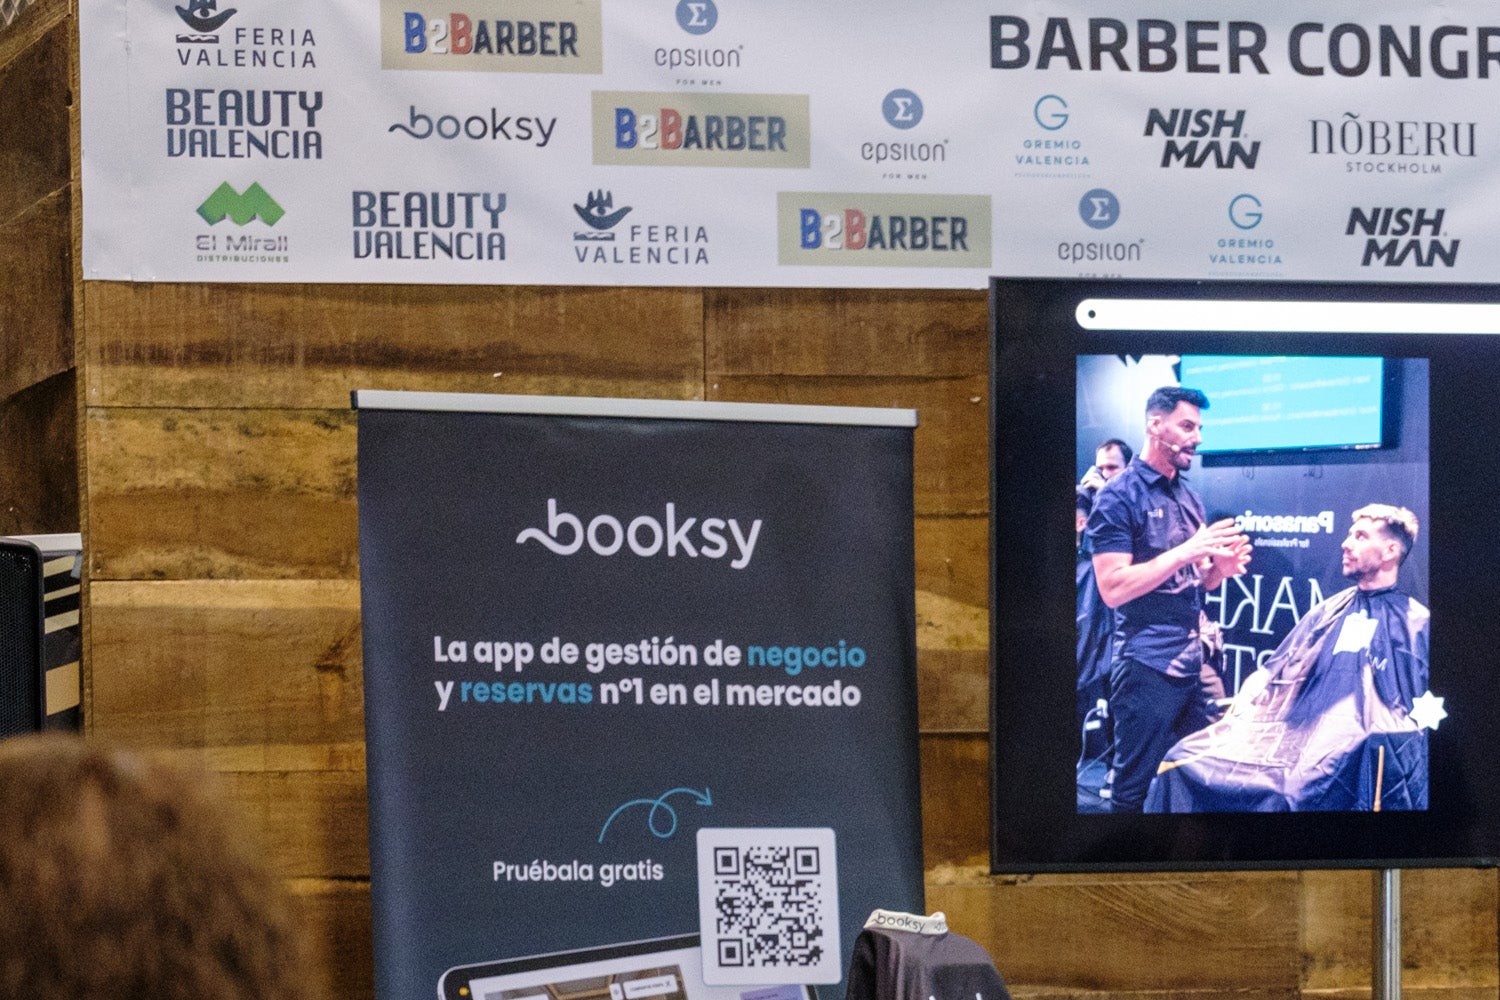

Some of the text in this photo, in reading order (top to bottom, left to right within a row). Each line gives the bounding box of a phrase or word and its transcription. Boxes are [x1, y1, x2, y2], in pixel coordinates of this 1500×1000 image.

[235, 28, 316, 46] FERIA
[404, 12, 579, 58] B2BARBER
[989, 15, 1270, 75] BARBER
[176, 50, 316, 68] VALENCIA
[167, 89, 323, 127] BEAUTY
[388, 105, 557, 147] booksy
[614, 107, 788, 151] B2BARBER
[1143, 108, 1246, 138] NISH
[167, 130, 322, 159] VALENCIA
[1023, 139, 1081, 149] GREMIO
[1160, 140, 1261, 169] MAN
[1015, 155, 1090, 165] VALENCIA
[1346, 162, 1442, 174] STOCKHOLM
[352, 191, 507, 229] BEAUTY
[1345, 207, 1446, 238] NISH
[196, 235, 288, 251] El Mirall
[630, 225, 709, 243] FERIA
[800, 208, 970, 251] B2BARBER
[1217, 238, 1274, 248] GREMIO
[353, 231, 506, 260] VALENCIA
[576, 246, 709, 264] VALENCIA
[1209, 255, 1282, 264] VALENCIA
[1362, 238, 1460, 268] MAN
[515, 497, 763, 570] booksy
[433, 636, 866, 676] La app de gestión de negocio
[434, 680, 454, 711] y
[460, 681, 594, 703] reservas
[649, 685, 688, 705] en
[692, 679, 720, 705] el
[725, 681, 862, 708] mercado
[492, 858, 664, 885] Pruébala gratis
[872, 913, 926, 932] booksy
